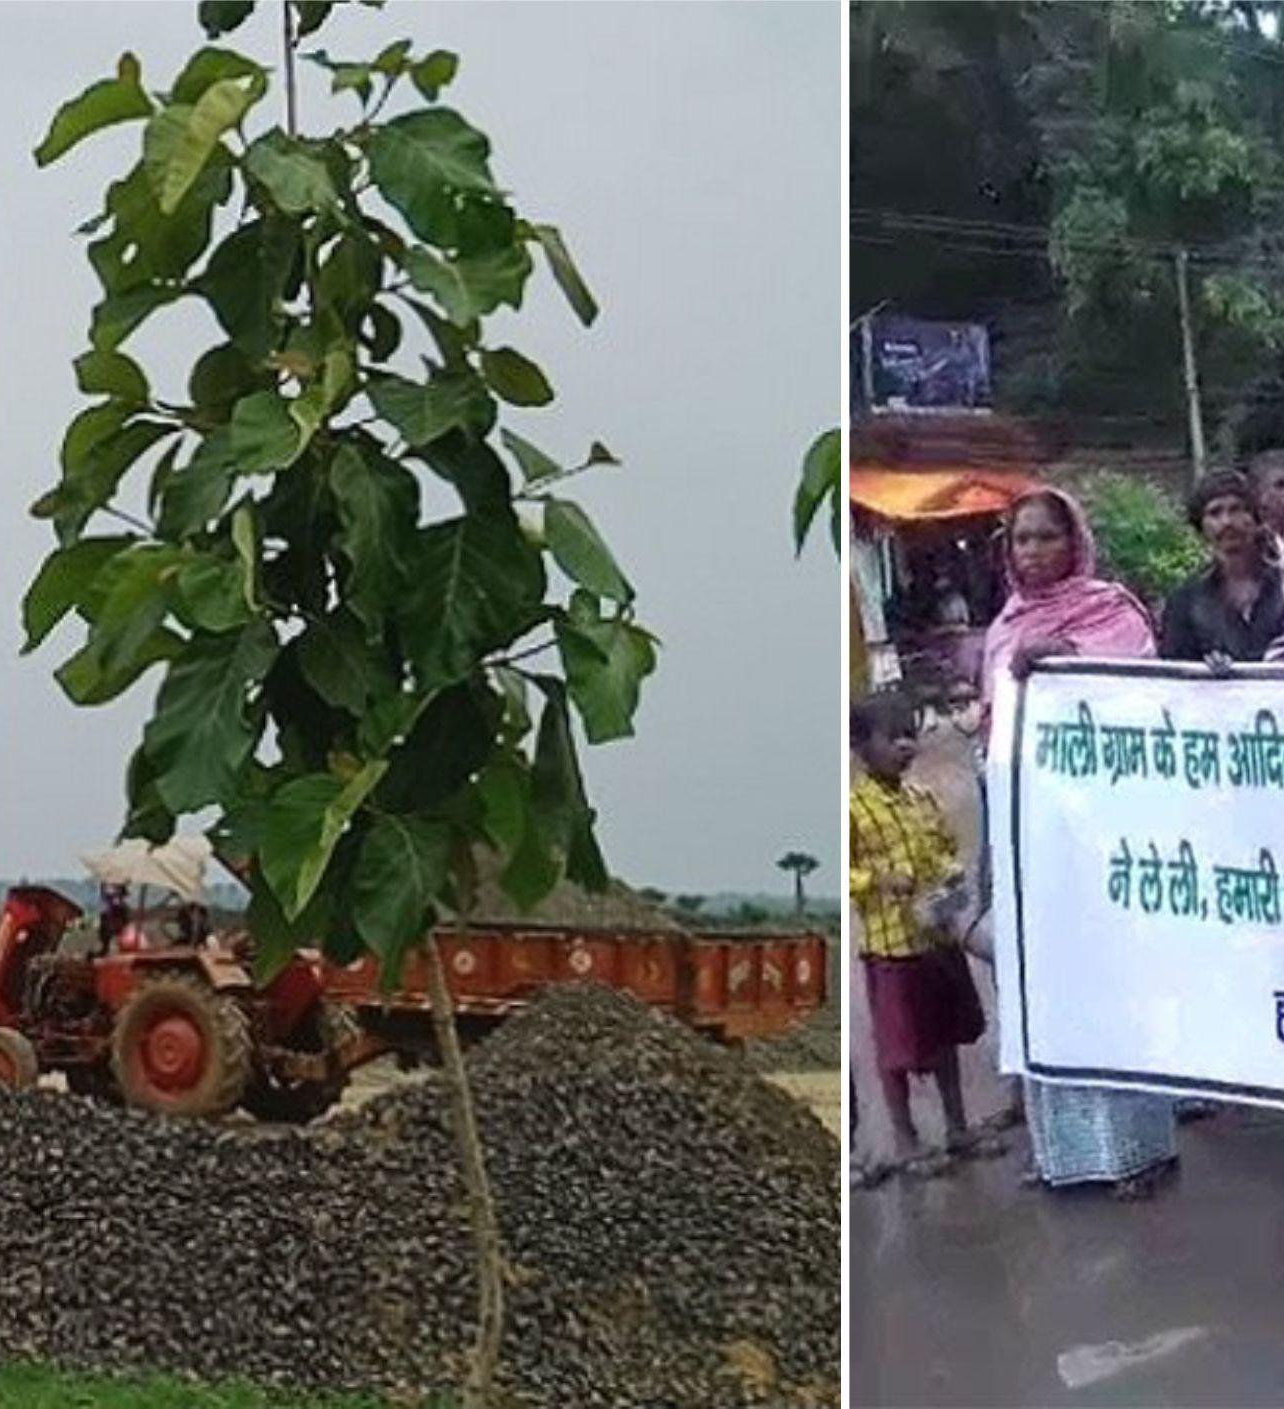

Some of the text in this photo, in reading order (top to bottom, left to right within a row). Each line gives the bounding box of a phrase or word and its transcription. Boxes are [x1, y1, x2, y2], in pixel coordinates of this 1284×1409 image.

[1036, 701, 1097, 778] माली
[1102, 722, 1147, 786] ग्राम
[1152, 710, 1178, 779] के
[1182, 727, 1221, 788] हम
[1108, 836, 1134, 911] ने
[1138, 843, 1165, 913] ले
[1215, 848, 1281, 926] हमारी
